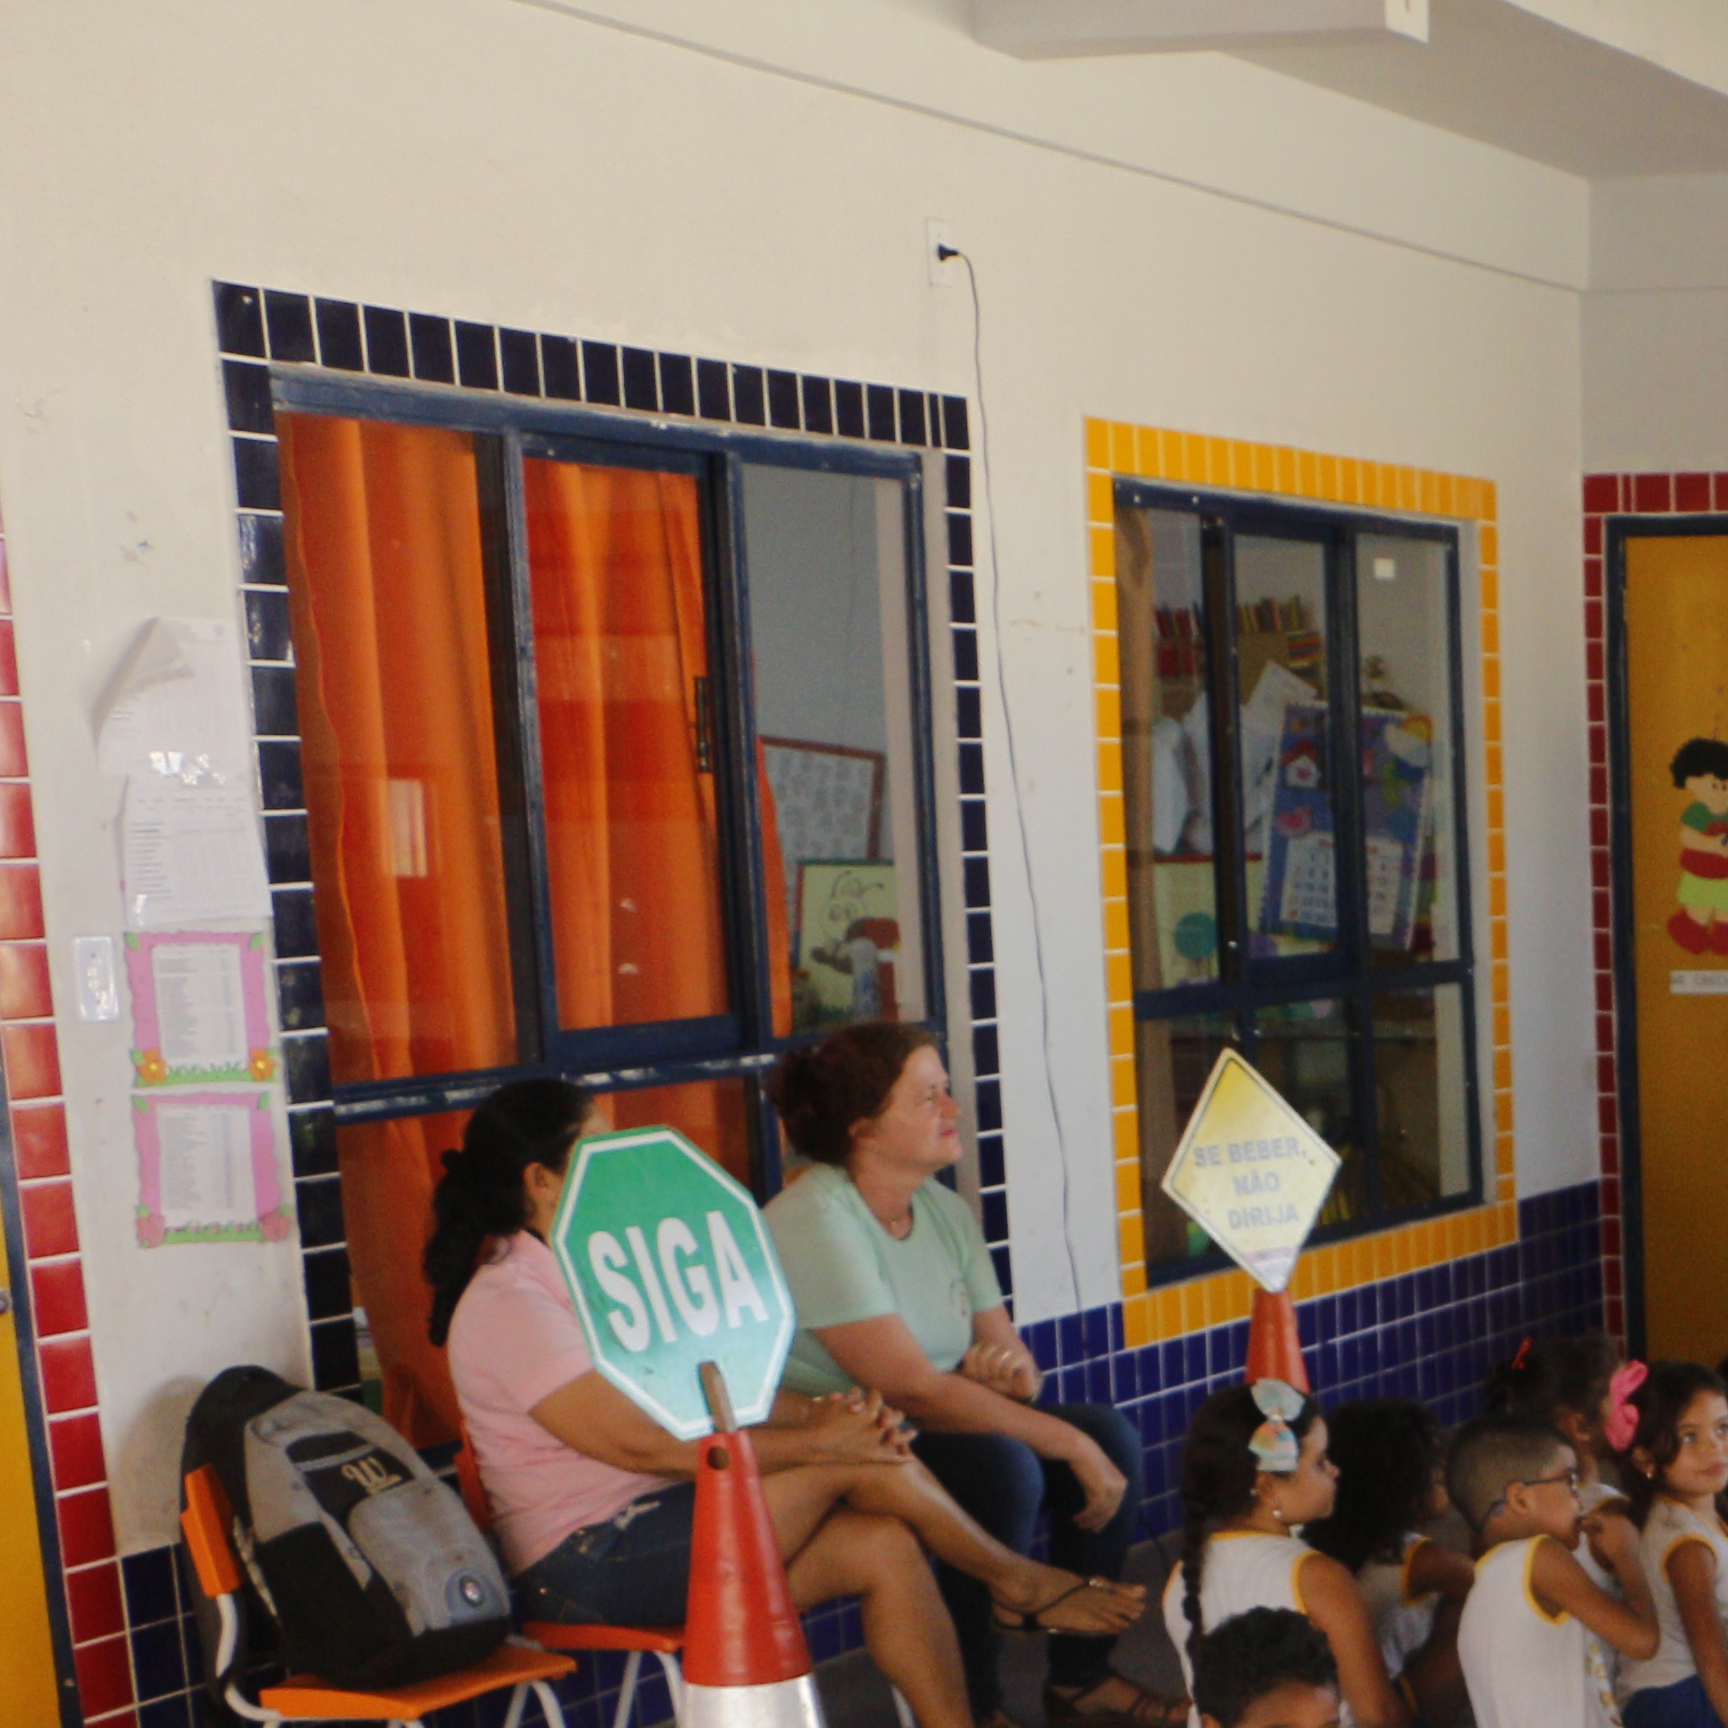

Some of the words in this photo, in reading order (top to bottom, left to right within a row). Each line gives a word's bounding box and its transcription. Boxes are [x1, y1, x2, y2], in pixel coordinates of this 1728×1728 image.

[1193, 1146, 1222, 1168] SE
[1229, 1136, 1308, 1164] BEBER,
[1232, 1169, 1281, 1196] NÃO
[1227, 1202, 1299, 1230] DIRIJA
[587, 1209, 771, 1353] SIGA
